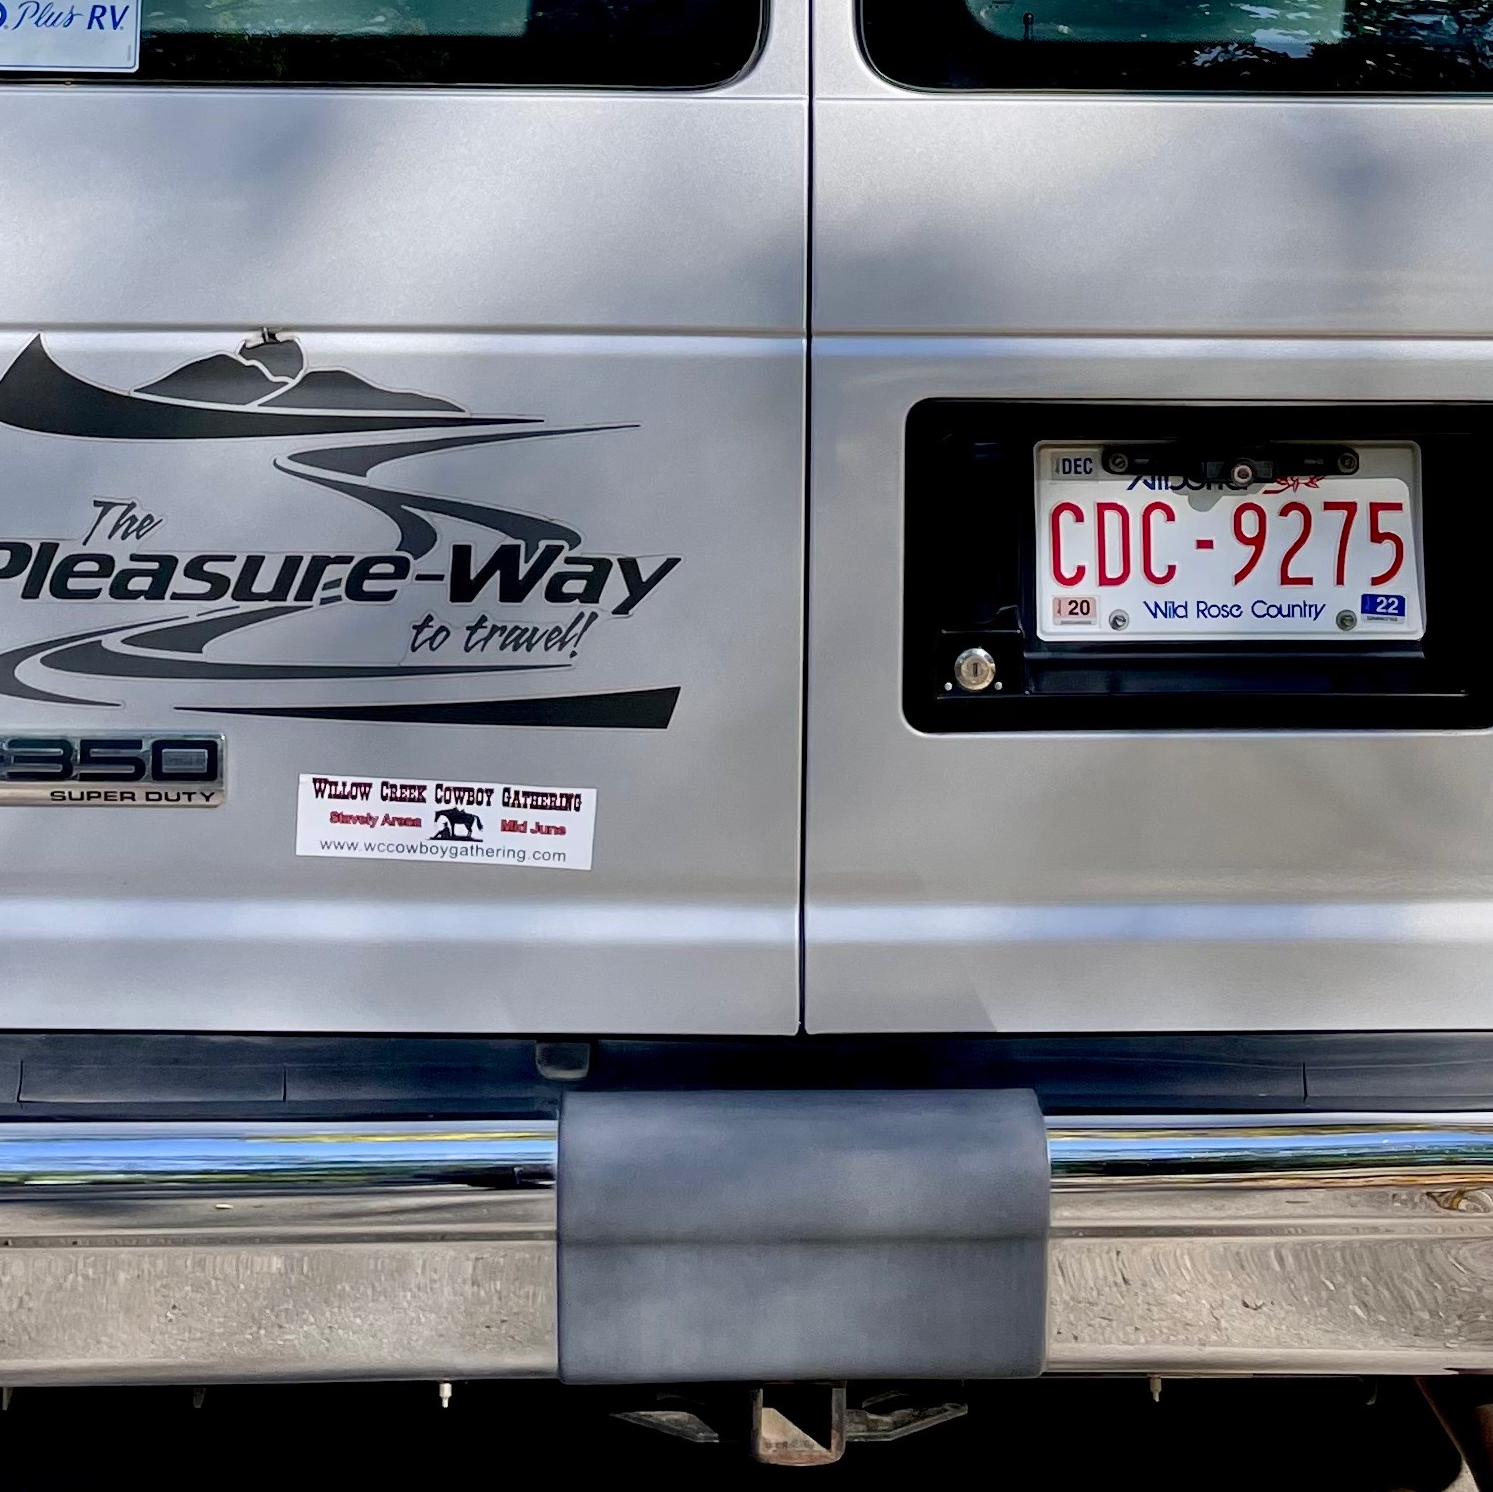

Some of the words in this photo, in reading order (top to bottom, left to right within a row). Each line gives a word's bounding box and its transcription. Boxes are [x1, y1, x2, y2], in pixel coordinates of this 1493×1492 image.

[12, 0, 84, 30] Plus
[87, 5, 130, 30] RV
[1062, 457, 1093, 475] DEC
[84, 499, 164, 546] The
[1049, 501, 1404, 587] CDC-9275
[1068, 599, 1090, 616] 20
[1143, 600, 1188, 619] Wild
[1196, 600, 1244, 619] Rose
[1251, 600, 1326, 621] Country
[1376, 596, 1399, 614] 22
[410, 613, 451, 653] to
[464, 611, 599, 659] travel!
[49, 790, 136, 803] SUPER
[145, 790, 216, 803] DUTY
[312, 777, 373, 801] WILLOW
[380, 781, 427, 804] CREEK
[434, 783, 494, 807] COWBOY
[502, 787, 582, 812] GATHERING
[500, 818, 527, 834] Mid
[529, 821, 567, 836] June
[319, 839, 567, 863] www.wccowboygathering.com
